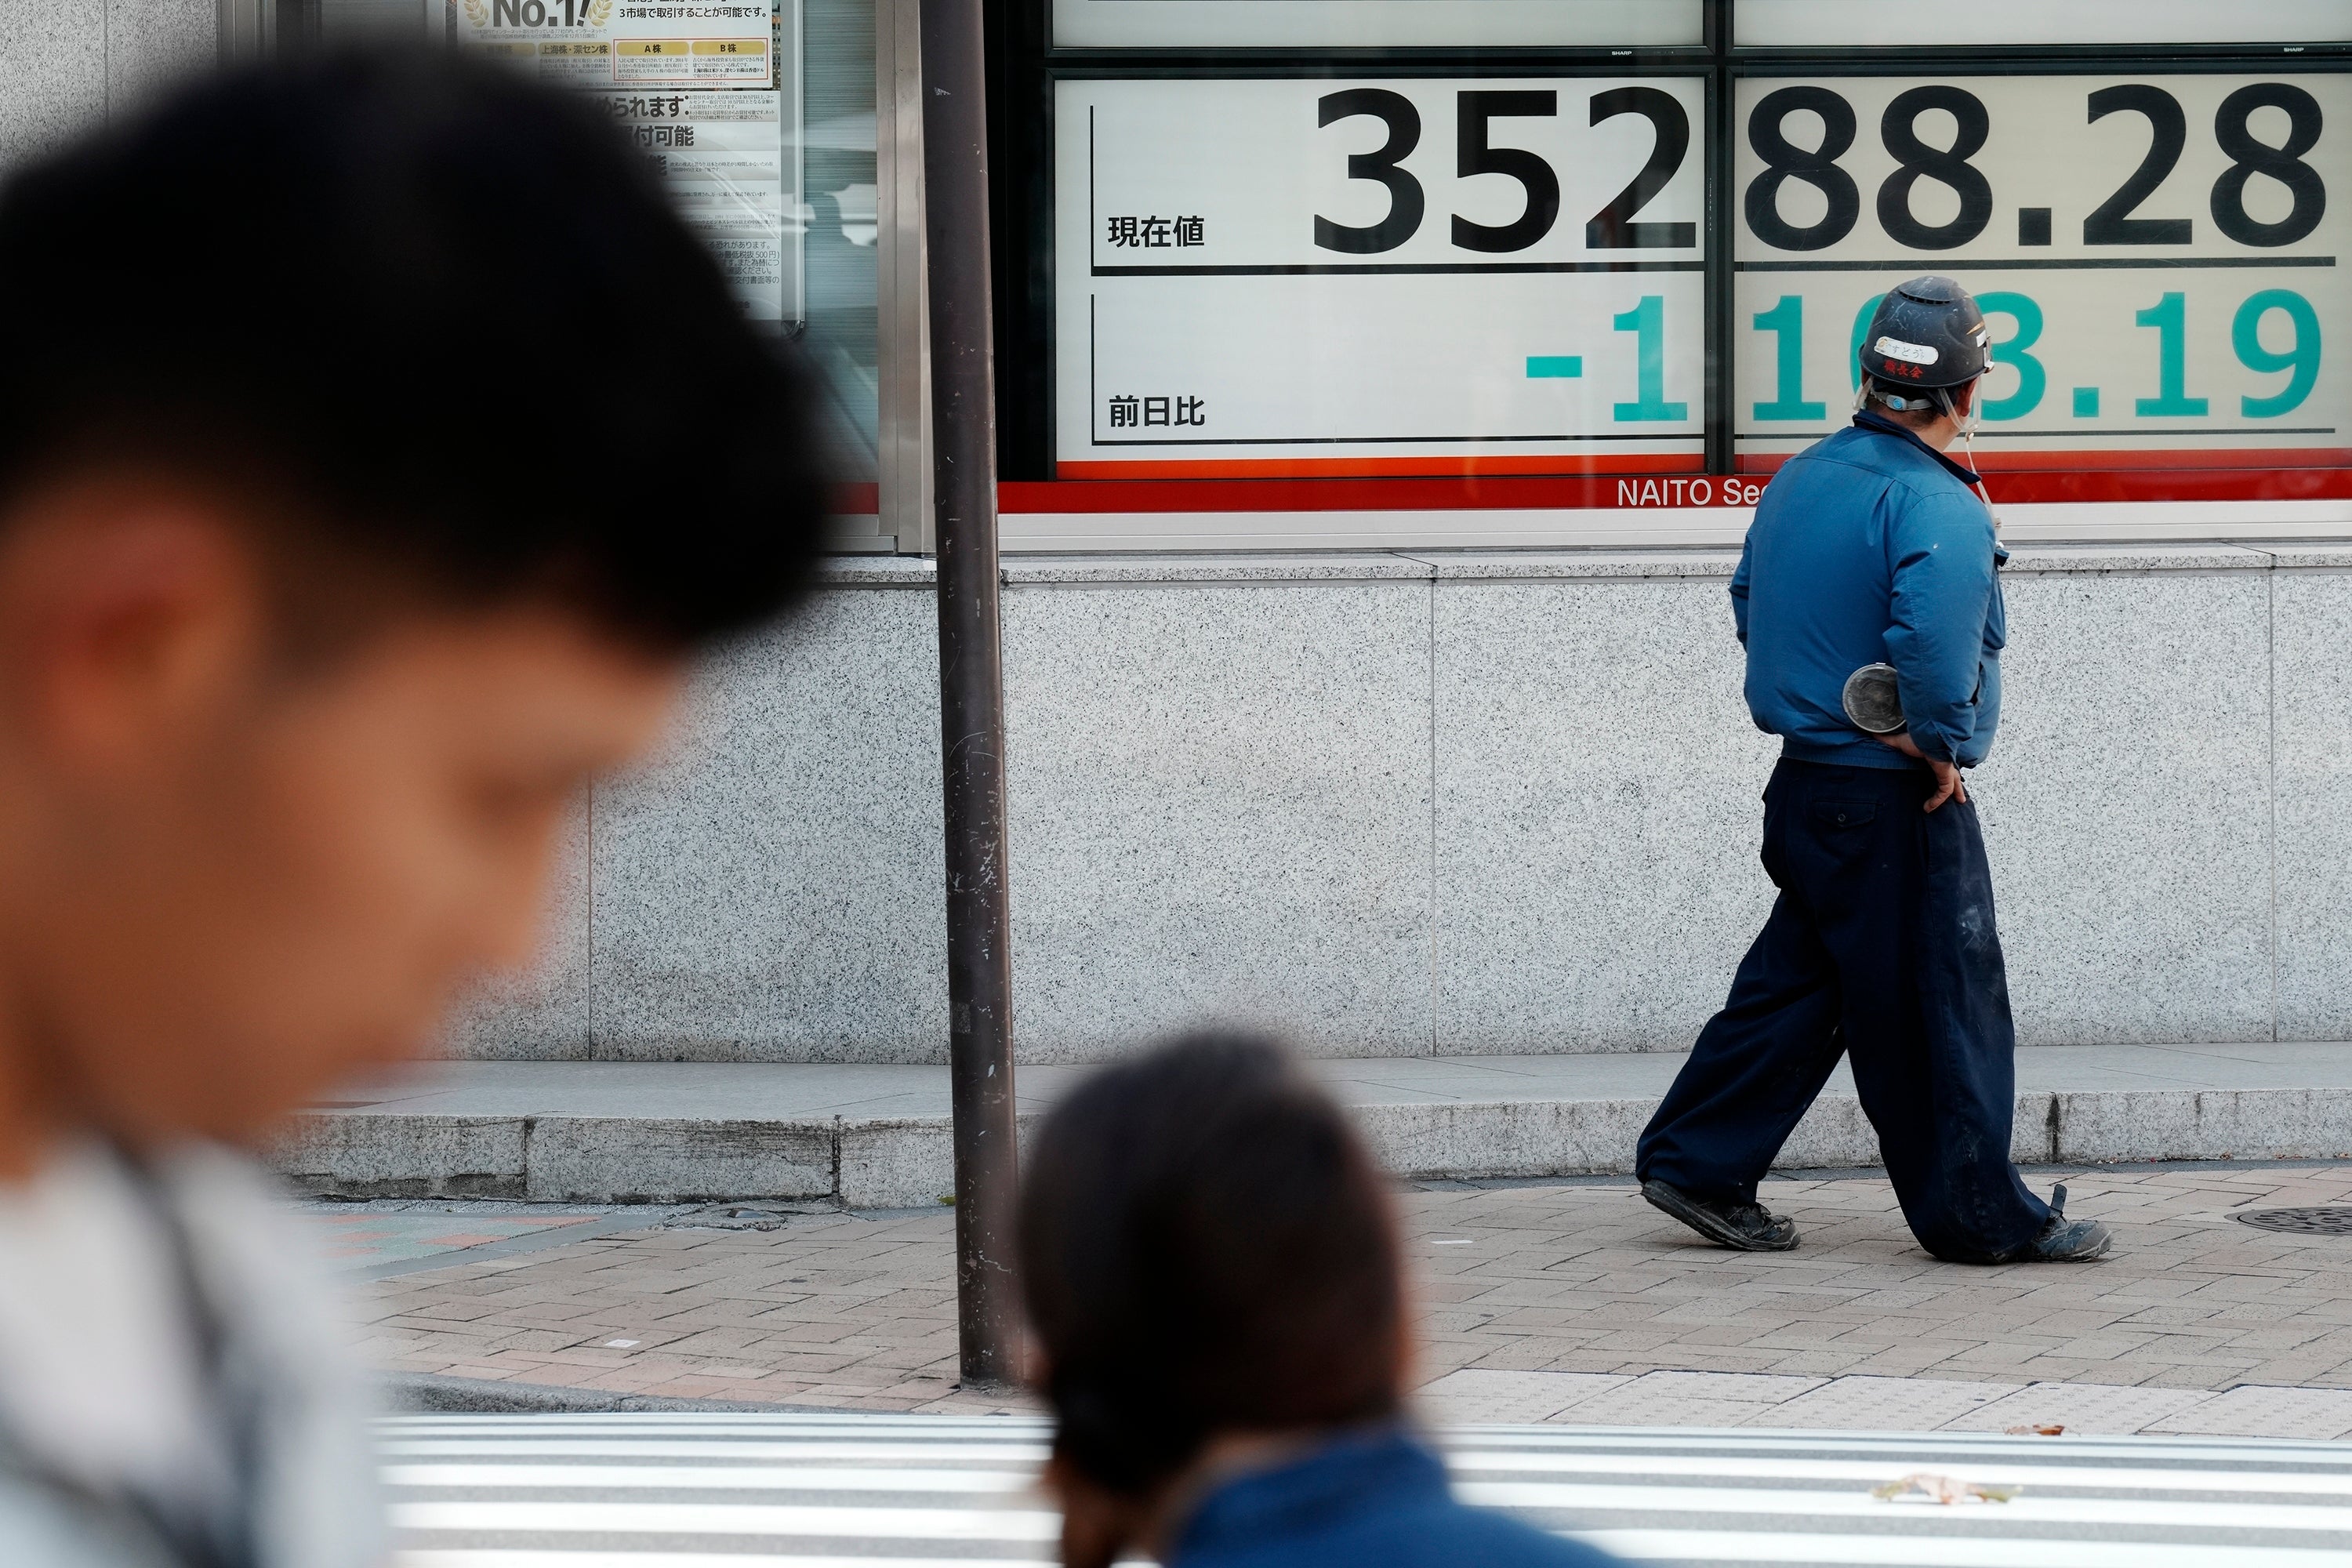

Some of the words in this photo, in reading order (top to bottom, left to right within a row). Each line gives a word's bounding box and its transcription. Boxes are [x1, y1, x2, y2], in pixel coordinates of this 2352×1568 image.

[493, 0, 590, 27] No.1!
[619, 6, 767, 19] 3市場で取引することが可能です。
[541, 45, 608, 55] 上海株・深セン株
[644, 44, 662, 54] A株
[720, 43, 737, 53] B株
[624, 125, 695, 147] 付可能
[1107, 215, 1205, 248] 現在値
[1314, 82, 2327, 254] 35288.28
[1109, 394, 1205, 427] 前日比
[1526, 289, 2322, 422] -113.19
[1617, 478, 1712, 506] NAITO
